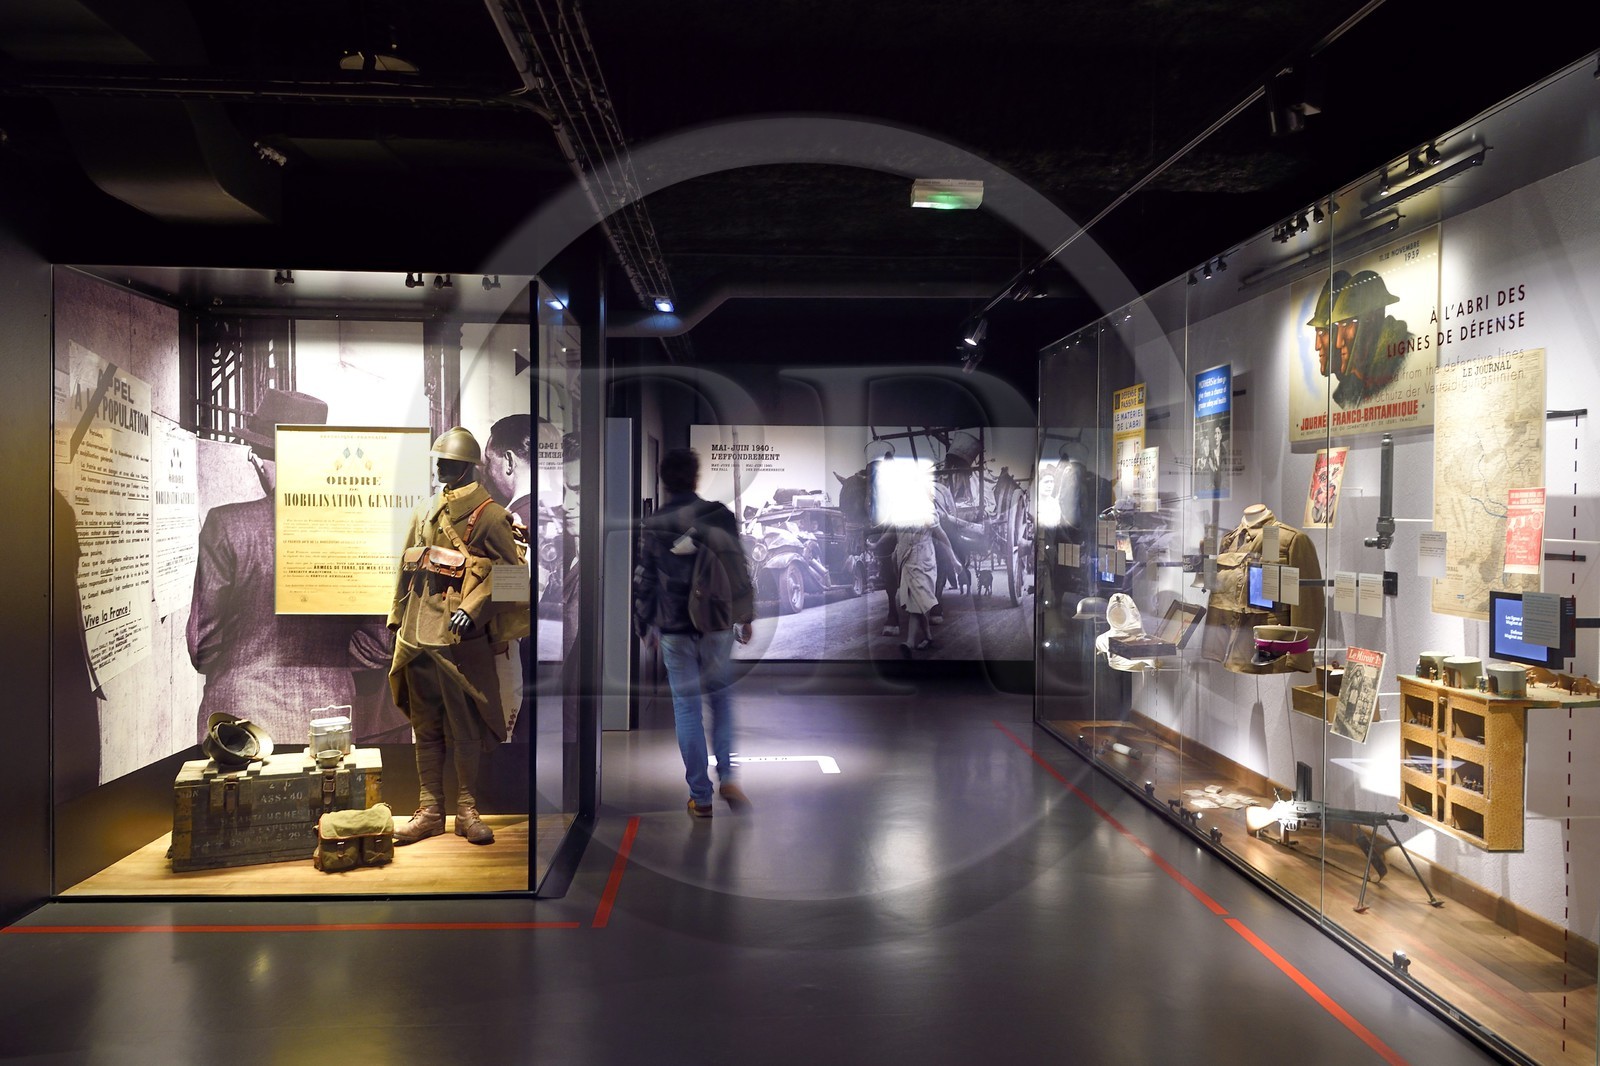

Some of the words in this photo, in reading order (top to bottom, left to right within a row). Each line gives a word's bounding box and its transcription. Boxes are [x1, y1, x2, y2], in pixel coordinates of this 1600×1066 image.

[1392, 240, 1420, 256] NOVEMBRE
[1404, 249, 1420, 261] 1939
[1429, 306, 1438, 325] À
[1445, 294, 1489, 321] L'ABRI
[1497, 284, 1526, 306] DES
[1387, 334, 1430, 358] LIGNES
[1436, 330, 1453, 347] DE
[1460, 311, 1526, 340] DÉFENSE
[1402, 367, 1424, 381] from
[1443, 353, 1494, 374] defensive
[1498, 347, 1525, 362] lines
[1462, 367, 1473, 378] LE
[1475, 359, 1512, 376] JOURNAL
[1406, 384, 1422, 399] der
[103, 396, 149, 437] POPULATION
[1300, 411, 1329, 431] JOURNÉ
[1332, 399, 1419, 427] FRANCO-BRITANNIQUE
[1117, 422, 1124, 431] DE
[711, 444, 750, 452] MAI-JUIN
[752, 444, 770, 452] 1940
[711, 453, 781, 461] L'EFFONDREMENT
[326, 476, 381, 486] ORDRE
[284, 493, 363, 508] MOBILISATION
[368, 494, 424, 509] GENERAL
[84, 614, 100, 628] Vive
[101, 609, 108, 622] la
[1349, 649, 1357, 660] Le
[1357, 651, 1375, 663] Miroir
